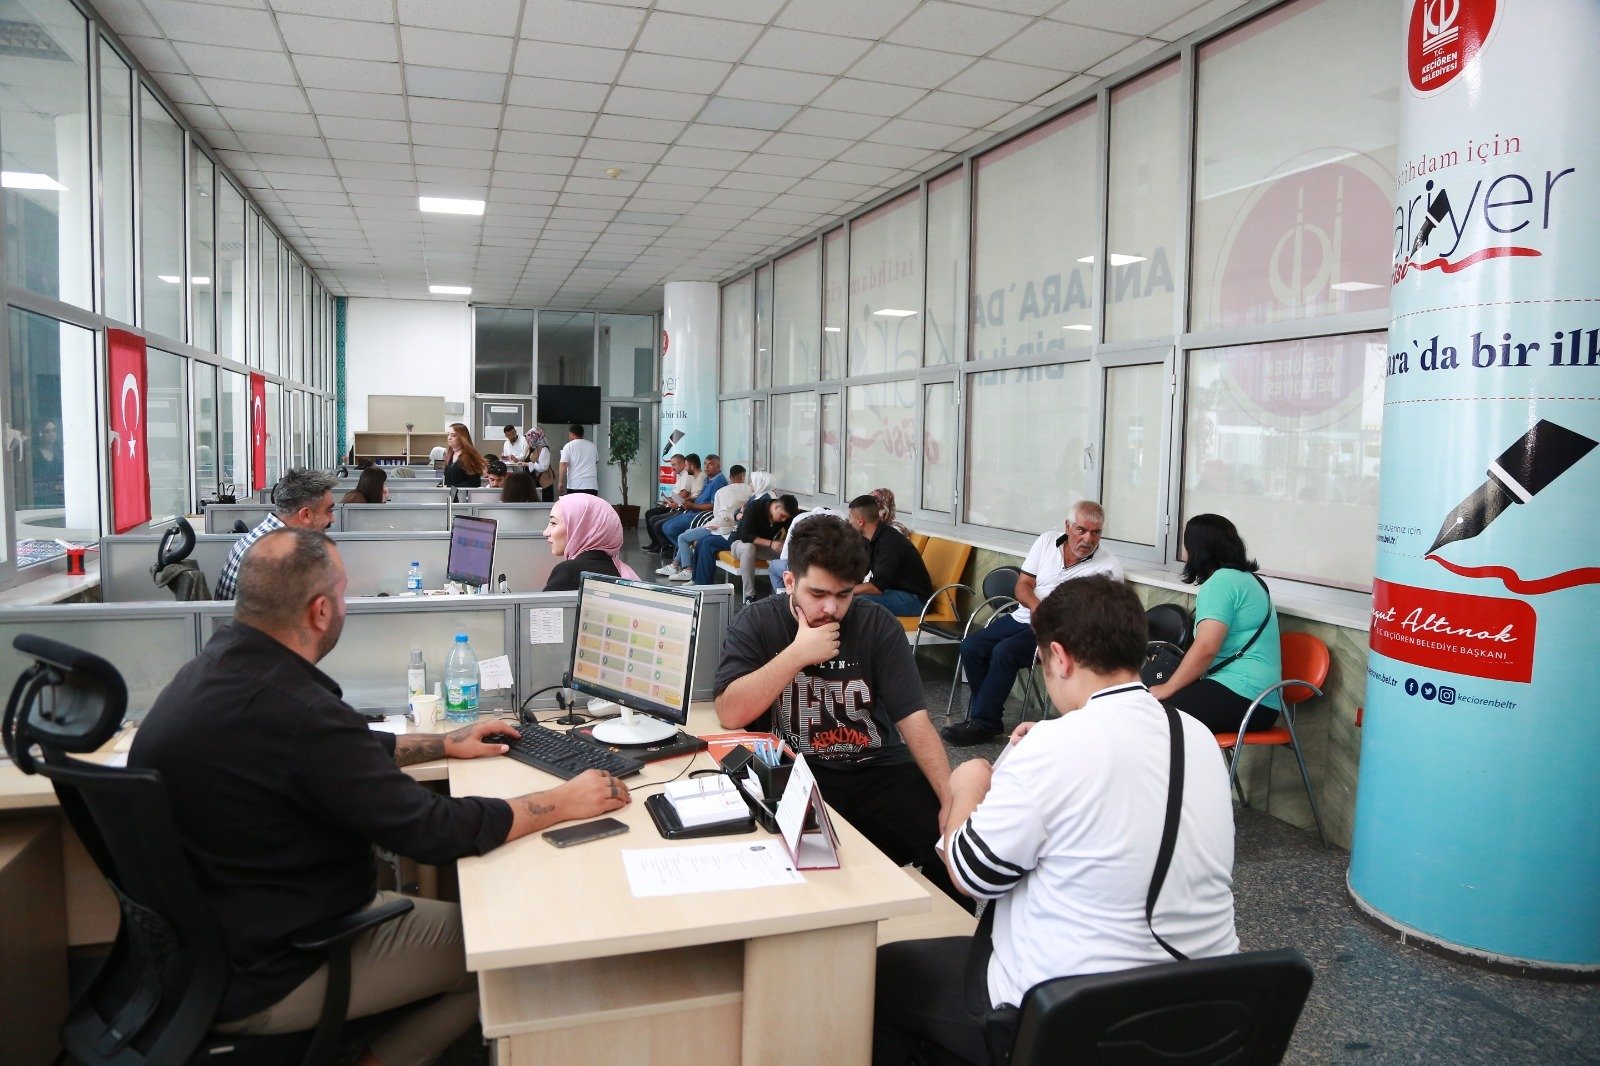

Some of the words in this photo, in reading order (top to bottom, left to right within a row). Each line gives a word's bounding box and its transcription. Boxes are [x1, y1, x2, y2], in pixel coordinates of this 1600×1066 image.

[1421, 51, 1458, 75] KEÇİÖREN
[1433, 47, 1445, 57] T.C.
[1421, 60, 1458, 84] BELEDİYESİ
[1467, 134, 1522, 164] için
[1393, 167, 1576, 258] ariyer
[1470, 331, 1540, 368] bir
[1401, 607, 1518, 643] Altınok
[1416, 638, 1458, 653] BELEDİYE
[1460, 646, 1508, 660] BAŞKANI
[818, 660, 846, 669] LYN
[1457, 693, 1517, 710] keciorenbeltr
